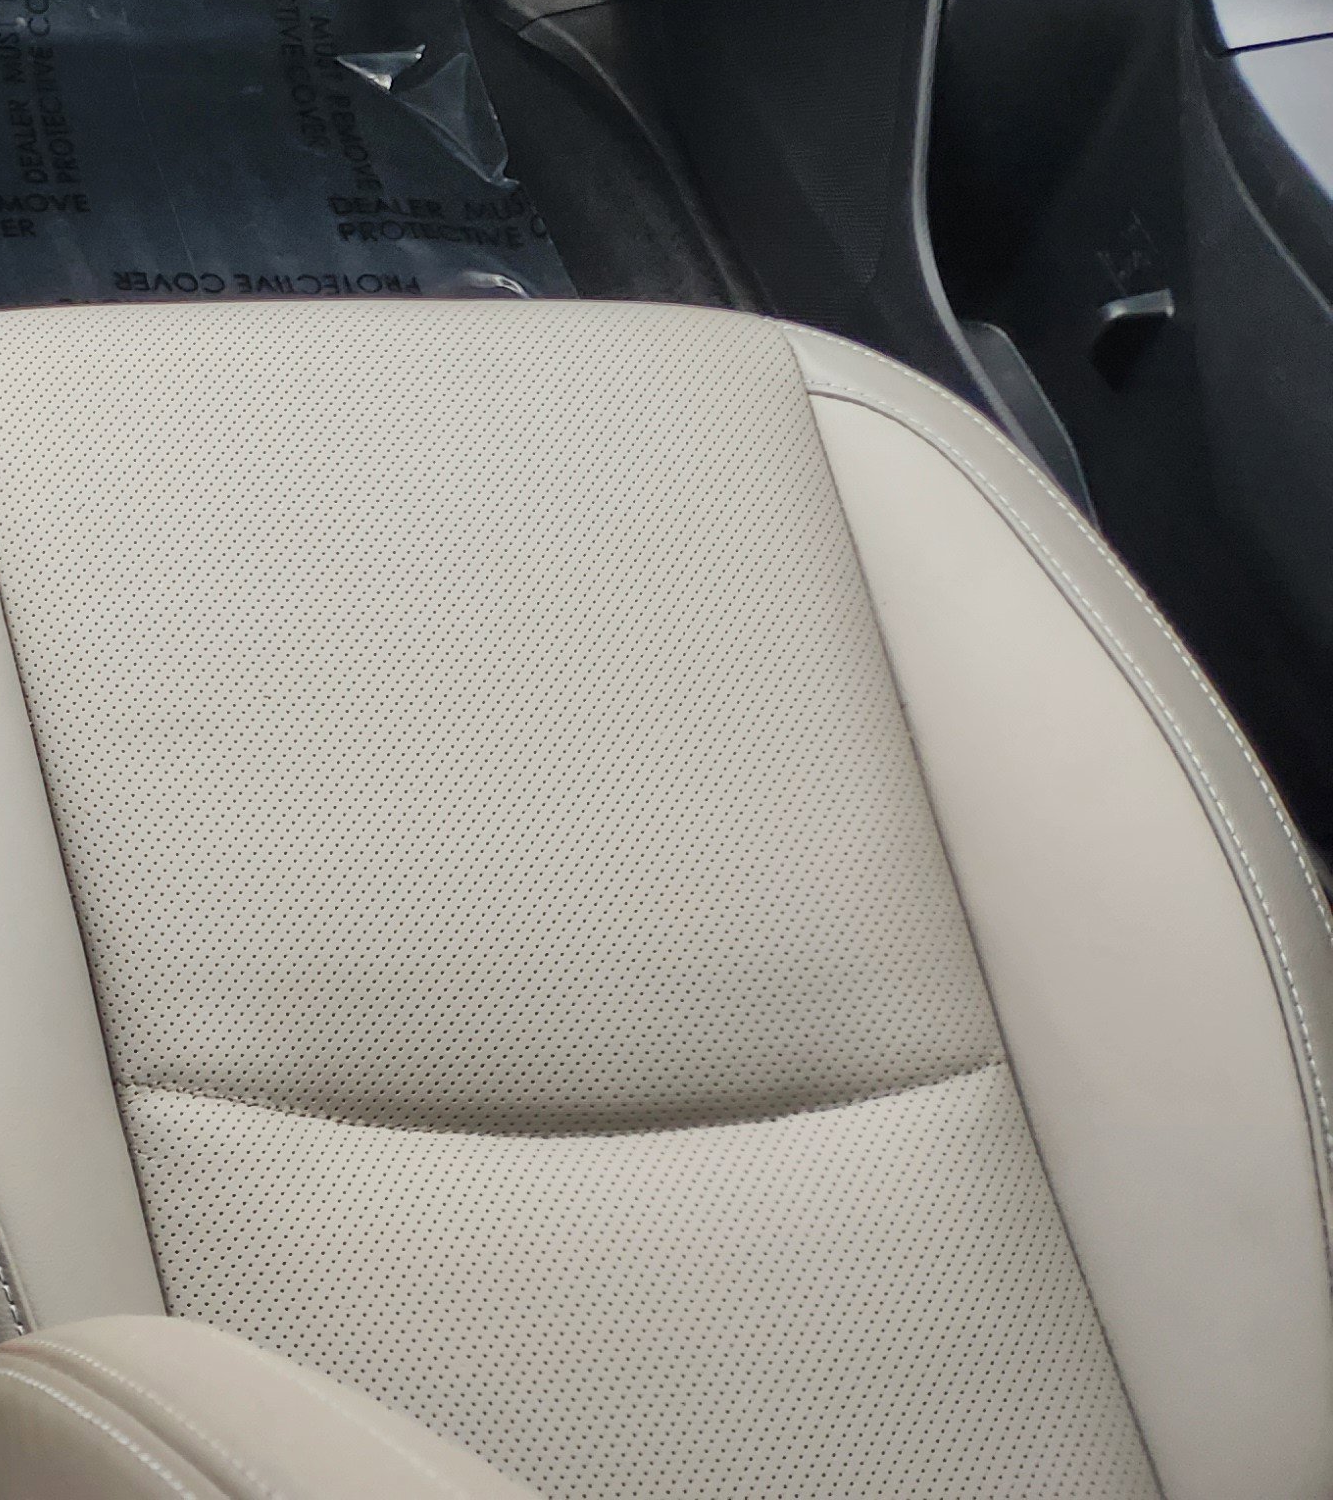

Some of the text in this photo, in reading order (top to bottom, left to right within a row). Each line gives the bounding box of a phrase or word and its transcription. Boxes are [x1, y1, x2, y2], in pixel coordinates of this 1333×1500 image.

[31, 40, 82, 184] PROTECTIVE
[7, 98, 48, 186] DEALER
[328, 196, 447, 219] DEALER
[337, 219, 525, 249] PROTECTIVE
[112, 271, 422, 296] PROTECTIVE COVER
